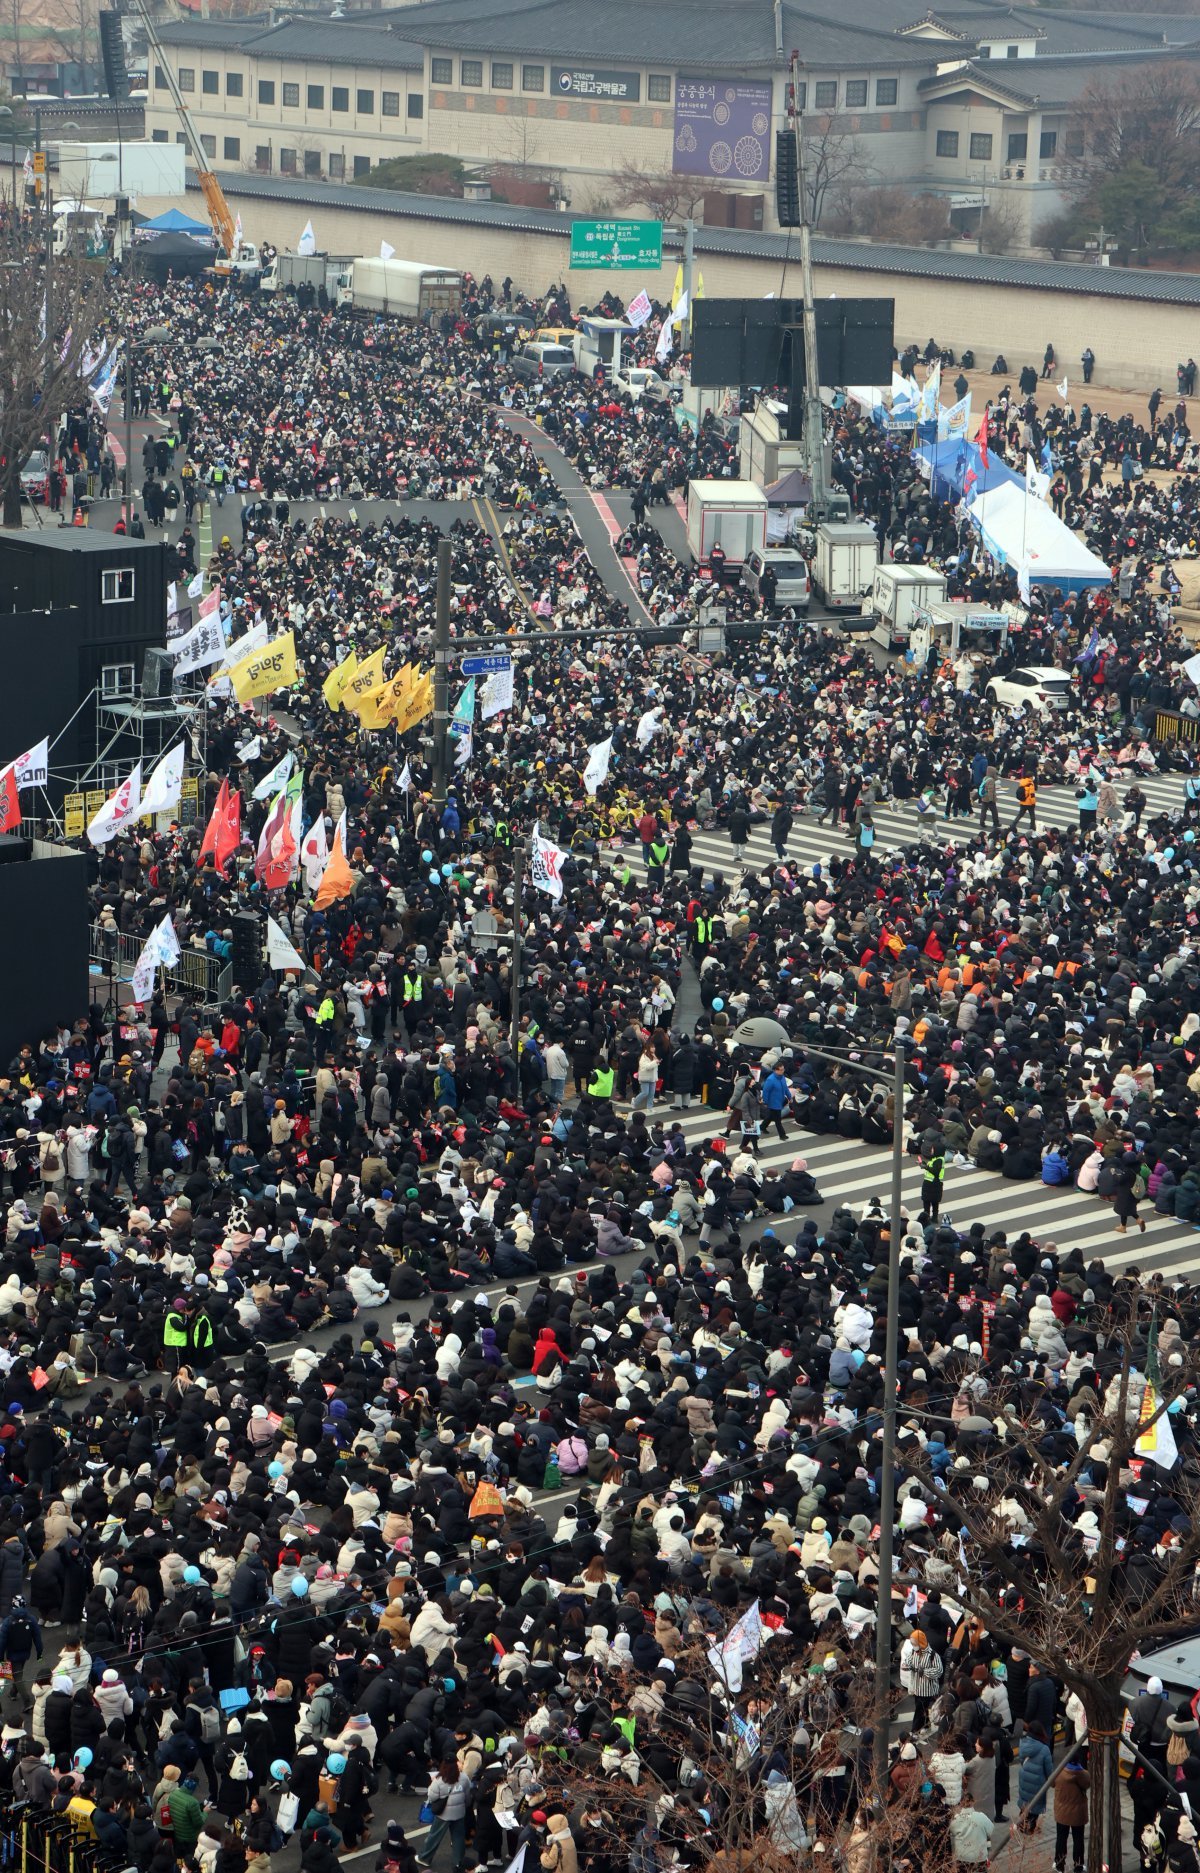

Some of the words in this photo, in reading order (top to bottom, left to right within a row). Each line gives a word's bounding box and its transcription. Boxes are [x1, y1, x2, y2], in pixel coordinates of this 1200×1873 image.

[572, 72, 594, 81] 국가유산청
[572, 80, 627, 96] 국립고궁박물관
[678, 85, 715, 100] 궁중음식
[595, 223, 616, 231] 수색역
[595, 232, 615, 241] 독립문
[639, 249, 658, 257] 효자동
[484, 657, 509, 666] 세종대로
